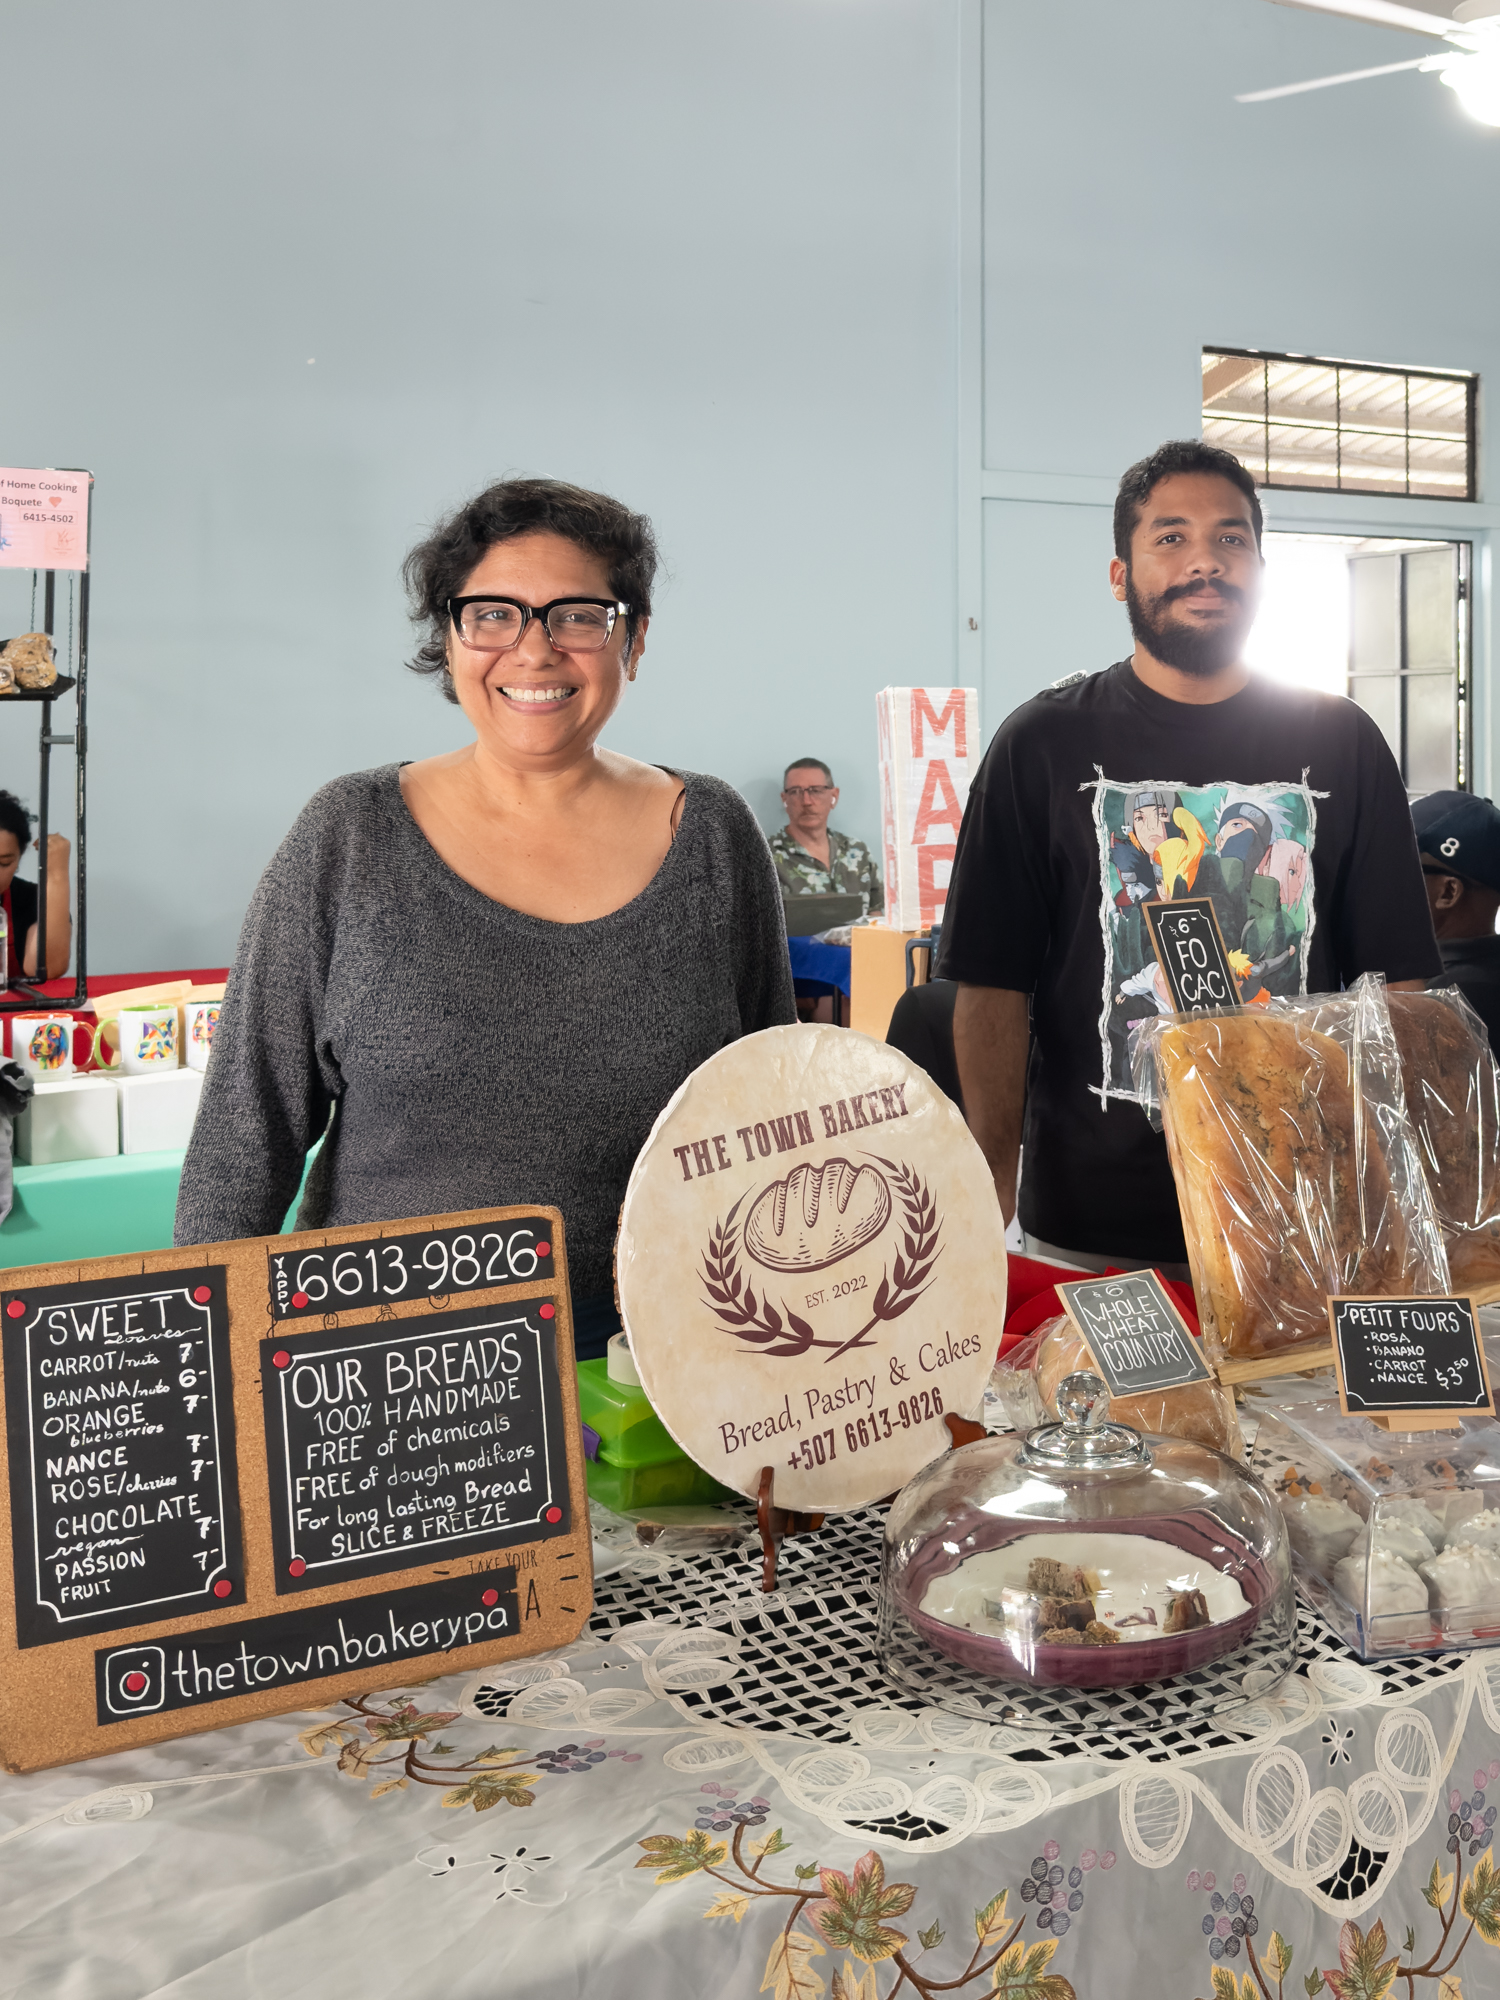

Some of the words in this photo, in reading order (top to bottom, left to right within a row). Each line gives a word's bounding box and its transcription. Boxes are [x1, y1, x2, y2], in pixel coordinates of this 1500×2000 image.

[1, 496, 42, 507] Boquete
[7, 480, 36, 490] Home
[38, 482, 78, 493] Cooking
[23, 513, 74, 523] 6415-4502
[1440, 837, 1460, 857] 8
[1175, 937, 1208, 971] FO
[1180, 970, 1226, 1002] CAC
[673, 1134, 733, 1182] THE
[736, 1109, 815, 1163] TOWN
[818, 1082, 909, 1139] BAKERY
[296, 1229, 539, 1302] 6613-9826
[273, 1256, 290, 1314] YAPPY
[804, 1288, 830, 1309] EST.
[832, 1275, 868, 1300] 2022
[48, 1295, 173, 1346] SWEET
[1083, 1295, 1156, 1322] WHOLE
[1349, 1307, 1393, 1328] PETIT
[1399, 1309, 1460, 1334] FOURS
[1092, 1312, 1160, 1340] WHEAT
[1370, 1331, 1411, 1344] ROSA
[1102, 1328, 1183, 1372] COUNTRY
[1372, 1345, 1425, 1357] BANANO
[1374, 1358, 1427, 1371] CARROT
[292, 1358, 368, 1409] OUR
[386, 1332, 522, 1394] BREADS
[313, 1402, 372, 1436] 100%
[384, 1377, 521, 1425] HANDMADE
[718, 1394, 802, 1454] Bread,
[803, 1375, 876, 1420] Pastry
[889, 1356, 910, 1385] &
[918, 1331, 982, 1372] Cakes
[42, 1402, 145, 1437] ORANGE
[70, 1423, 165, 1448] blueberries
[787, 1428, 837, 1470] +507
[844, 1386, 944, 1453] 6613-9826
[306, 1435, 364, 1470] FREE
[376, 1429, 398, 1457] of
[406, 1415, 511, 1452] chemicals
[46, 1446, 129, 1479] NANCE
[296, 1471, 356, 1503] FREE
[359, 1465, 379, 1491] of
[387, 1454, 450, 1487] dough
[454, 1443, 536, 1473] modifiers
[55, 1493, 202, 1539] CHOCOLATE
[296, 1508, 331, 1531] For
[337, 1504, 378, 1530] long
[387, 1490, 457, 1518] lasting
[464, 1468, 533, 1504] Bread
[45, 1534, 144, 1560] vegan
[331, 1524, 397, 1558] SLICE
[402, 1525, 414, 1541] &
[421, 1502, 511, 1538] FREEZE
[55, 1547, 146, 1584] PASSION
[505, 1549, 538, 1572] YOUR
[61, 1579, 111, 1604] FRUIT
[171, 1607, 509, 1698] thetownbakerypa
